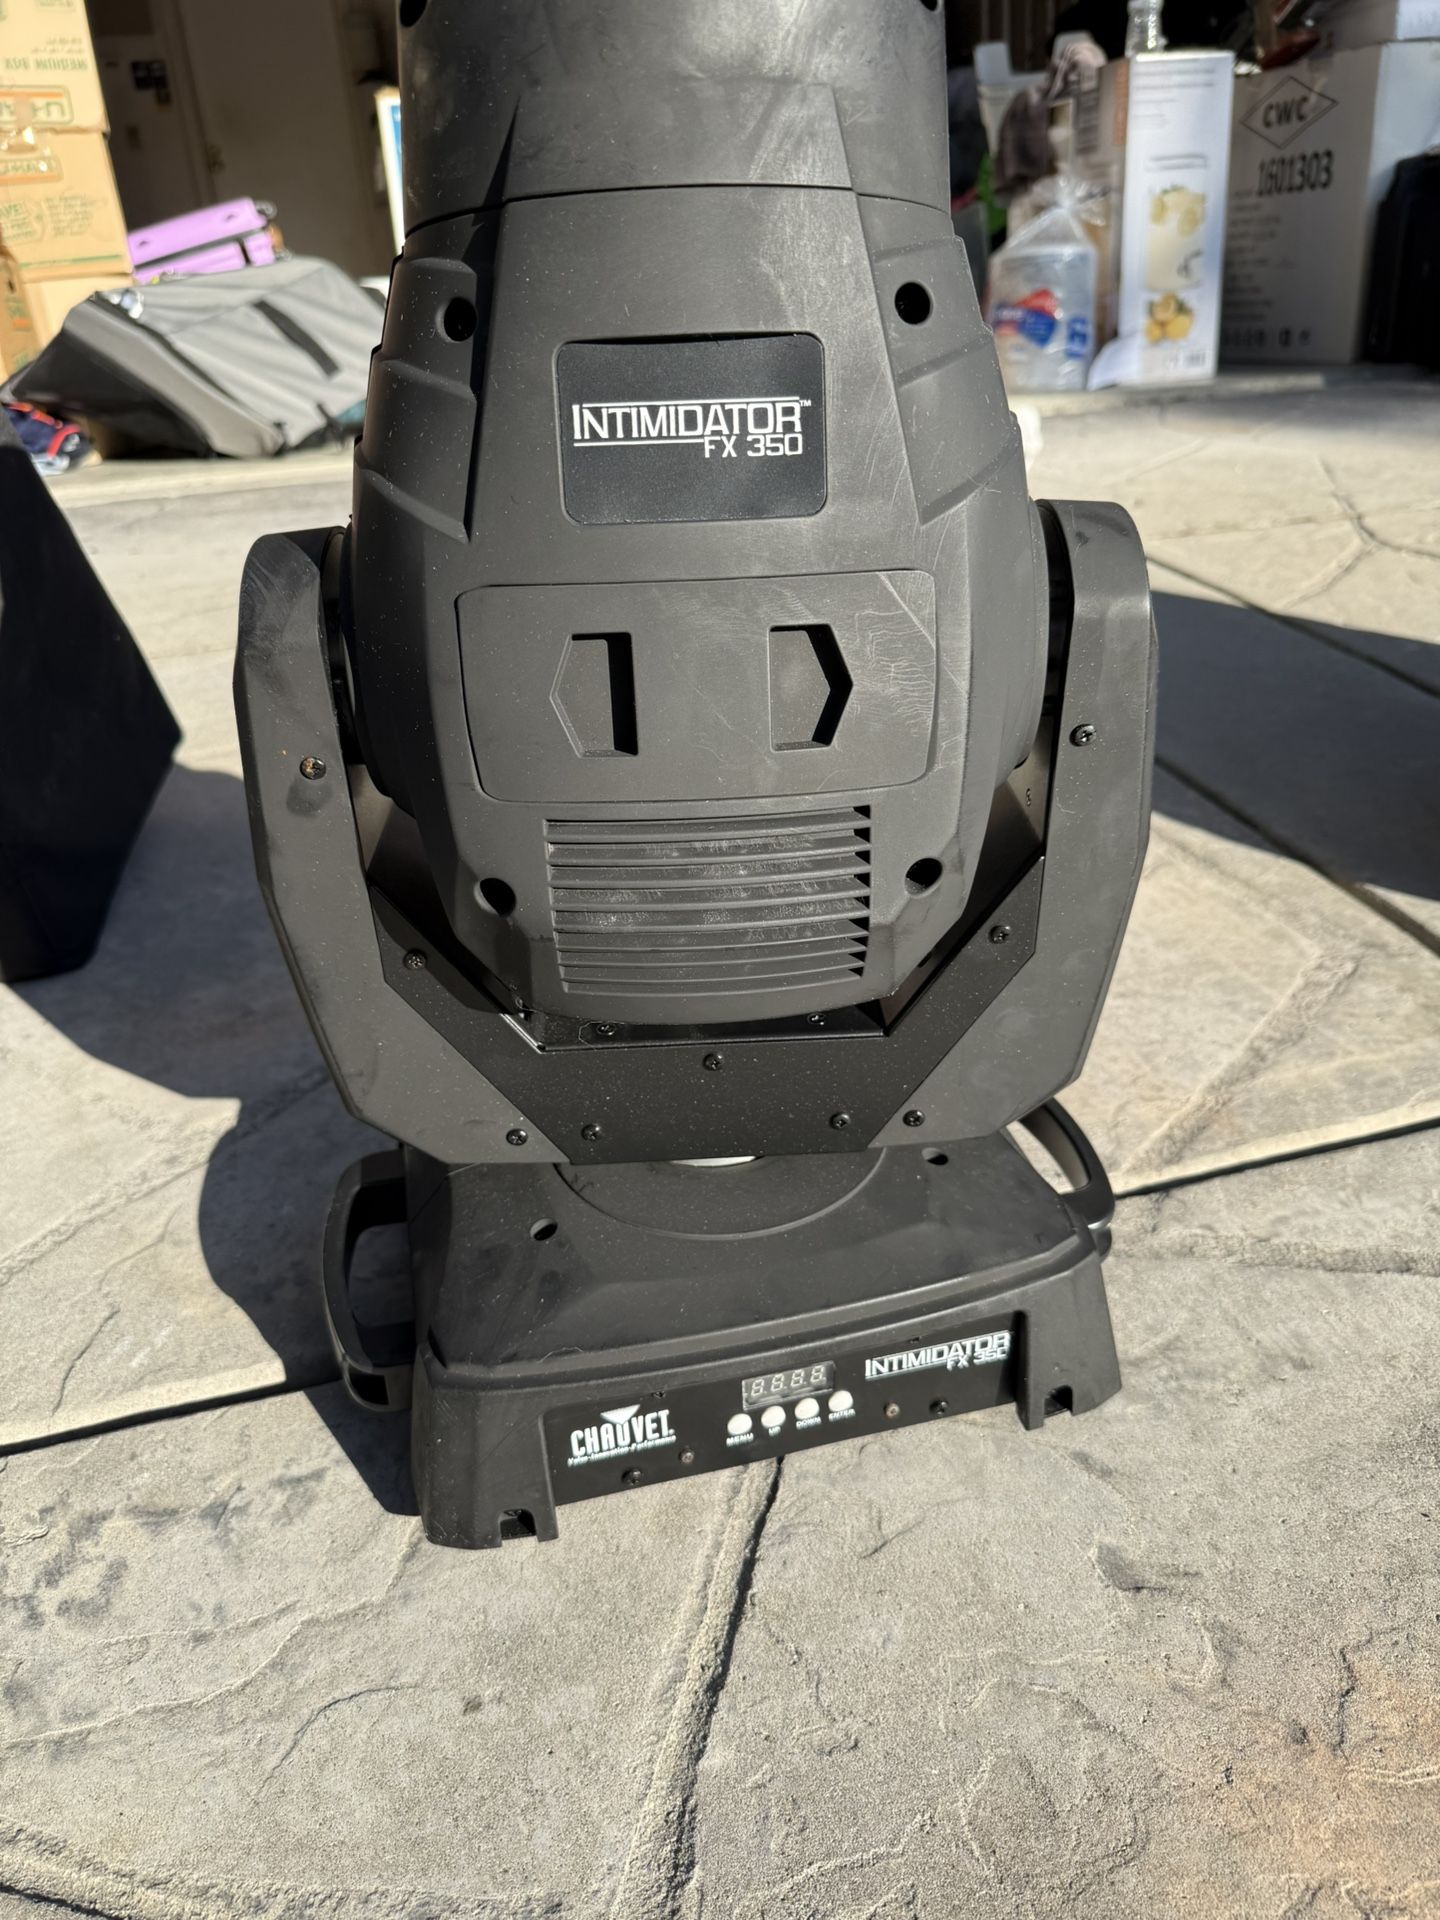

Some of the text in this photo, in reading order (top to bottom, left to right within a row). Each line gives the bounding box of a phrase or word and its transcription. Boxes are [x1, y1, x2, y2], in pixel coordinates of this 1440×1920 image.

[1262, 96, 1310, 129] CWC
[1257, 149, 1335, 197] 1601303
[572, 401, 802, 440] INTIMIDATOR
[703, 433, 803, 458] FX 350
[865, 1332, 1011, 1378] INTIMIDATOR
[946, 1355, 970, 1371] FX
[796, 1416, 822, 1430] DOWN
[828, 1408, 856, 1421] ENTER
[726, 1432, 754, 1446] MENU
[768, 1426, 781, 1436] UP
